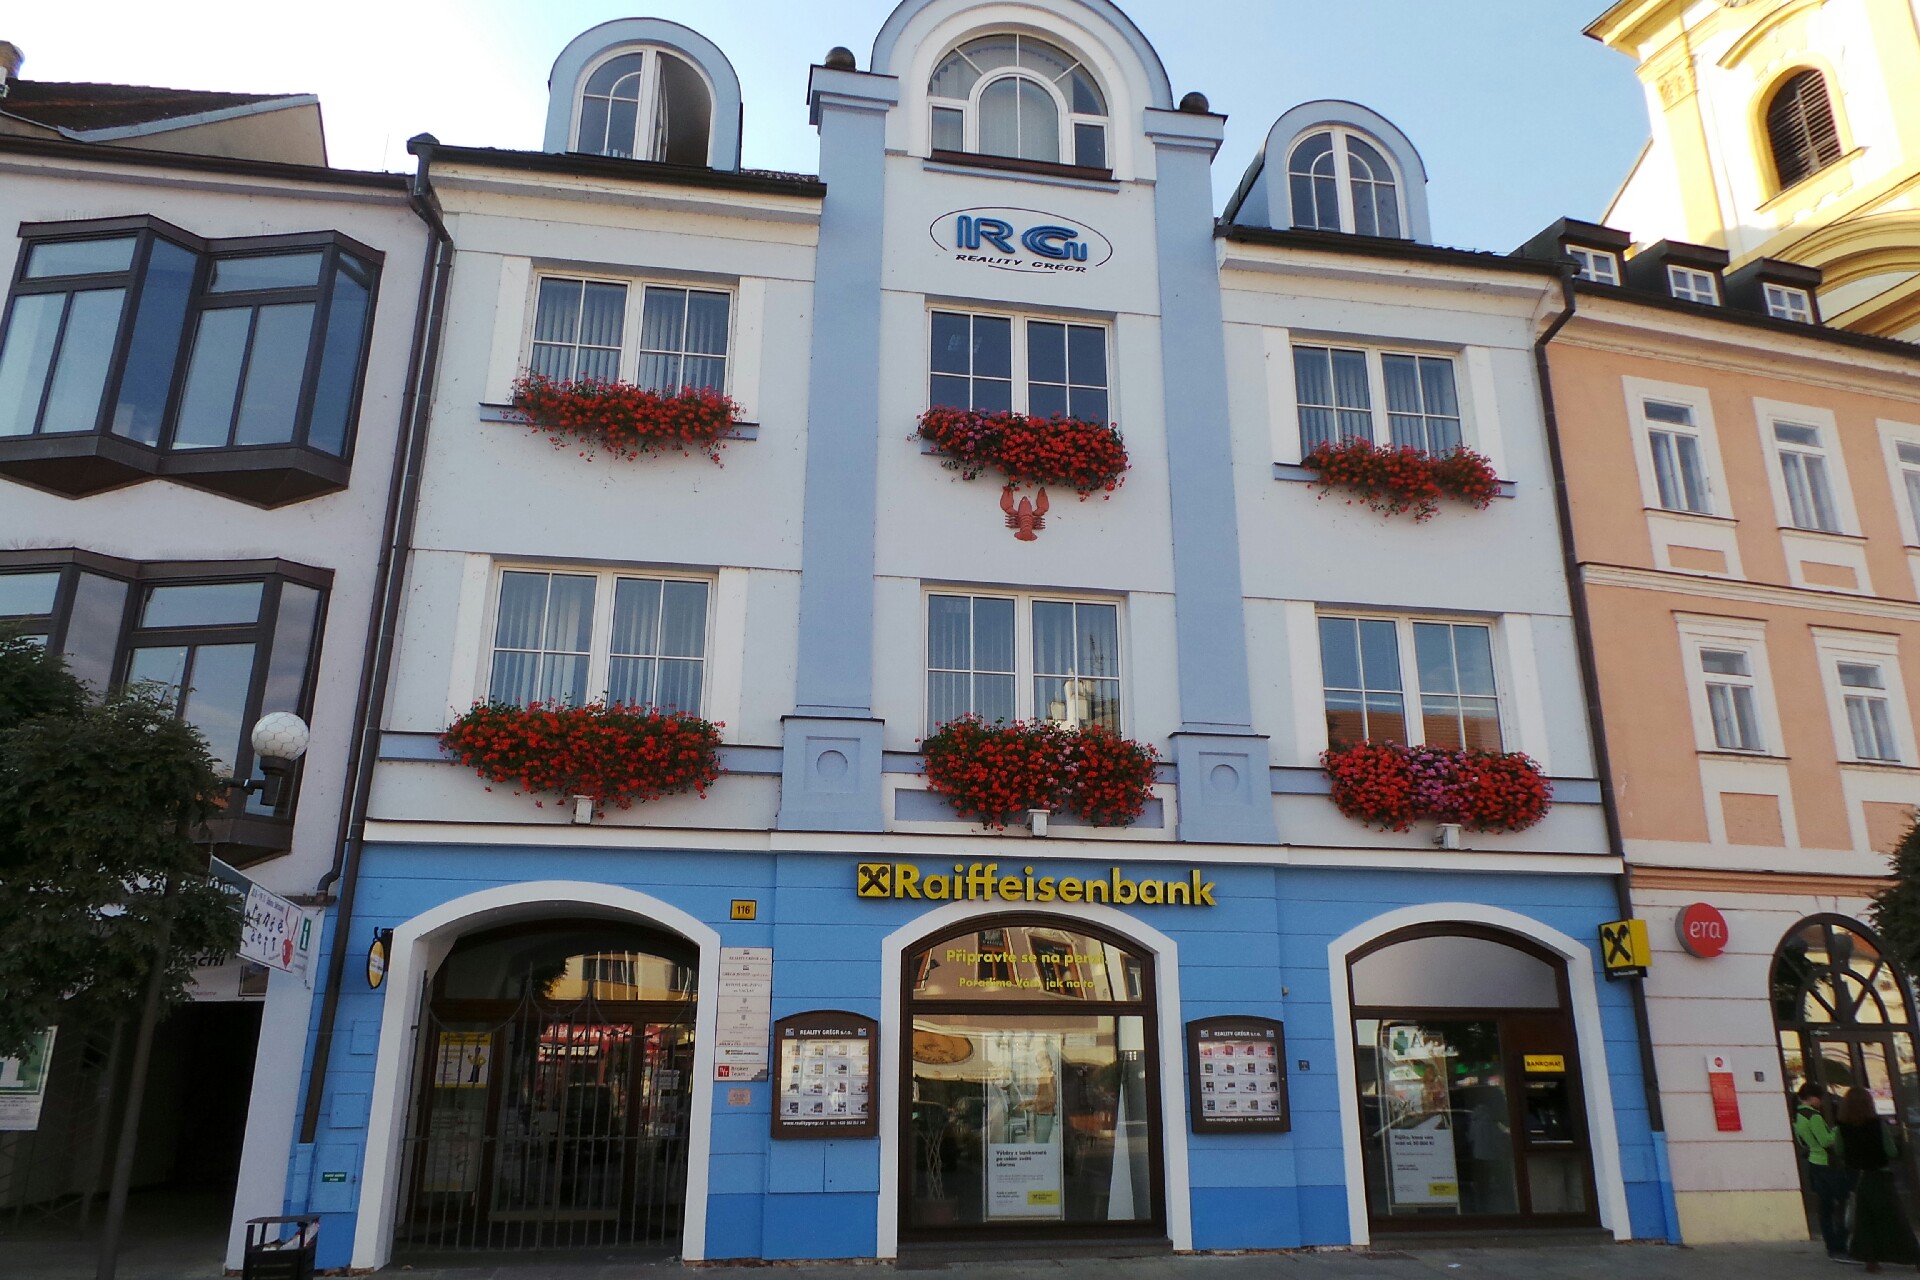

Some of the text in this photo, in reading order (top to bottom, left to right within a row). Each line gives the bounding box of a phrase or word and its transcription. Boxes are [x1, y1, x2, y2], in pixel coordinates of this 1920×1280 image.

[955, 254, 1087, 274] REALITY GRÉGR
[894, 863, 1217, 906] Raiffeisenbank
[737, 905, 751, 915] 116
[1689, 921, 1722, 939] era
[946, 949, 1017, 967] Připravte
[1021, 953, 1038, 963] se
[1041, 953, 1060, 963] na
[959, 977, 1012, 988] Poradíme
[1046, 978, 1063, 990] jak
[1066, 980, 1080, 988] na
